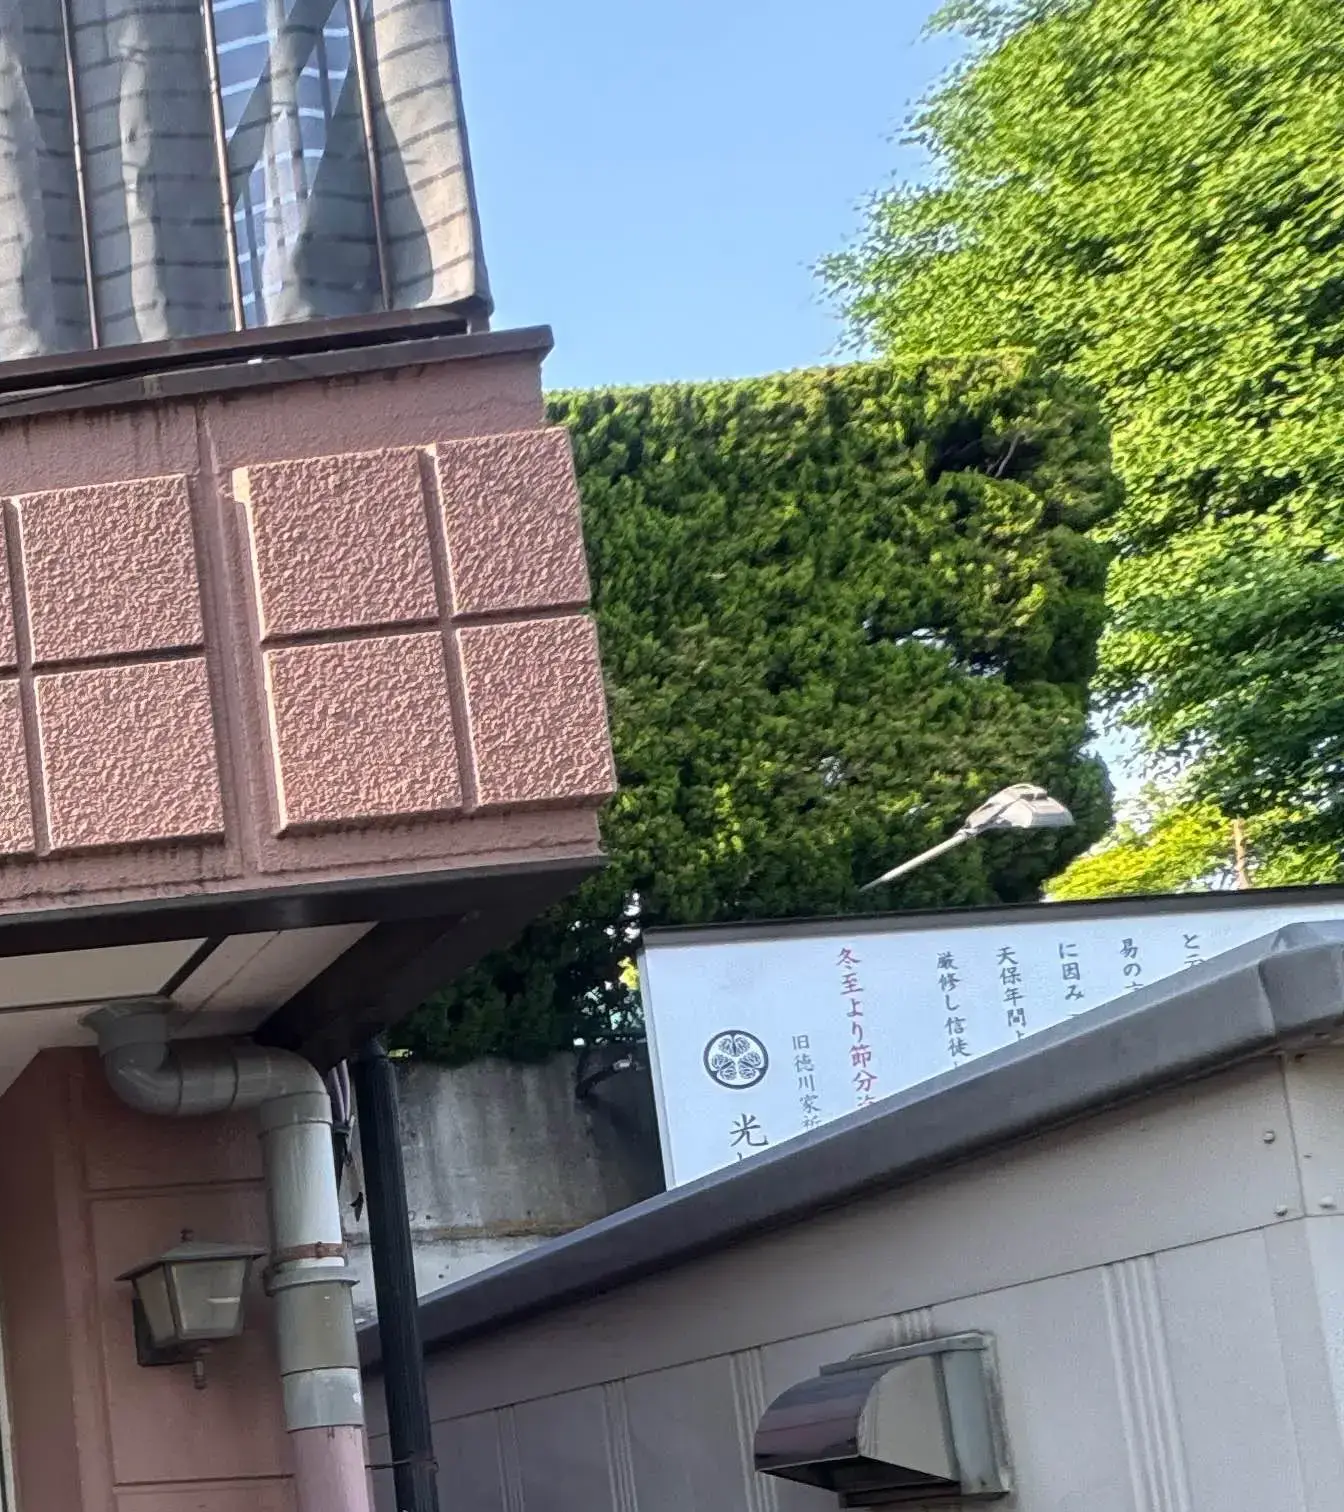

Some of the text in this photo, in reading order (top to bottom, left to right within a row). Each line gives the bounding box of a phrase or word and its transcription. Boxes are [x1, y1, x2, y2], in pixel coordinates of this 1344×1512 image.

[1059, 942, 1085, 1016] に因み
[1120, 937, 1144, 990] 易の
[936, 951, 971, 1068] 厳修し信徒
[730, 1112, 769, 1160] 光
